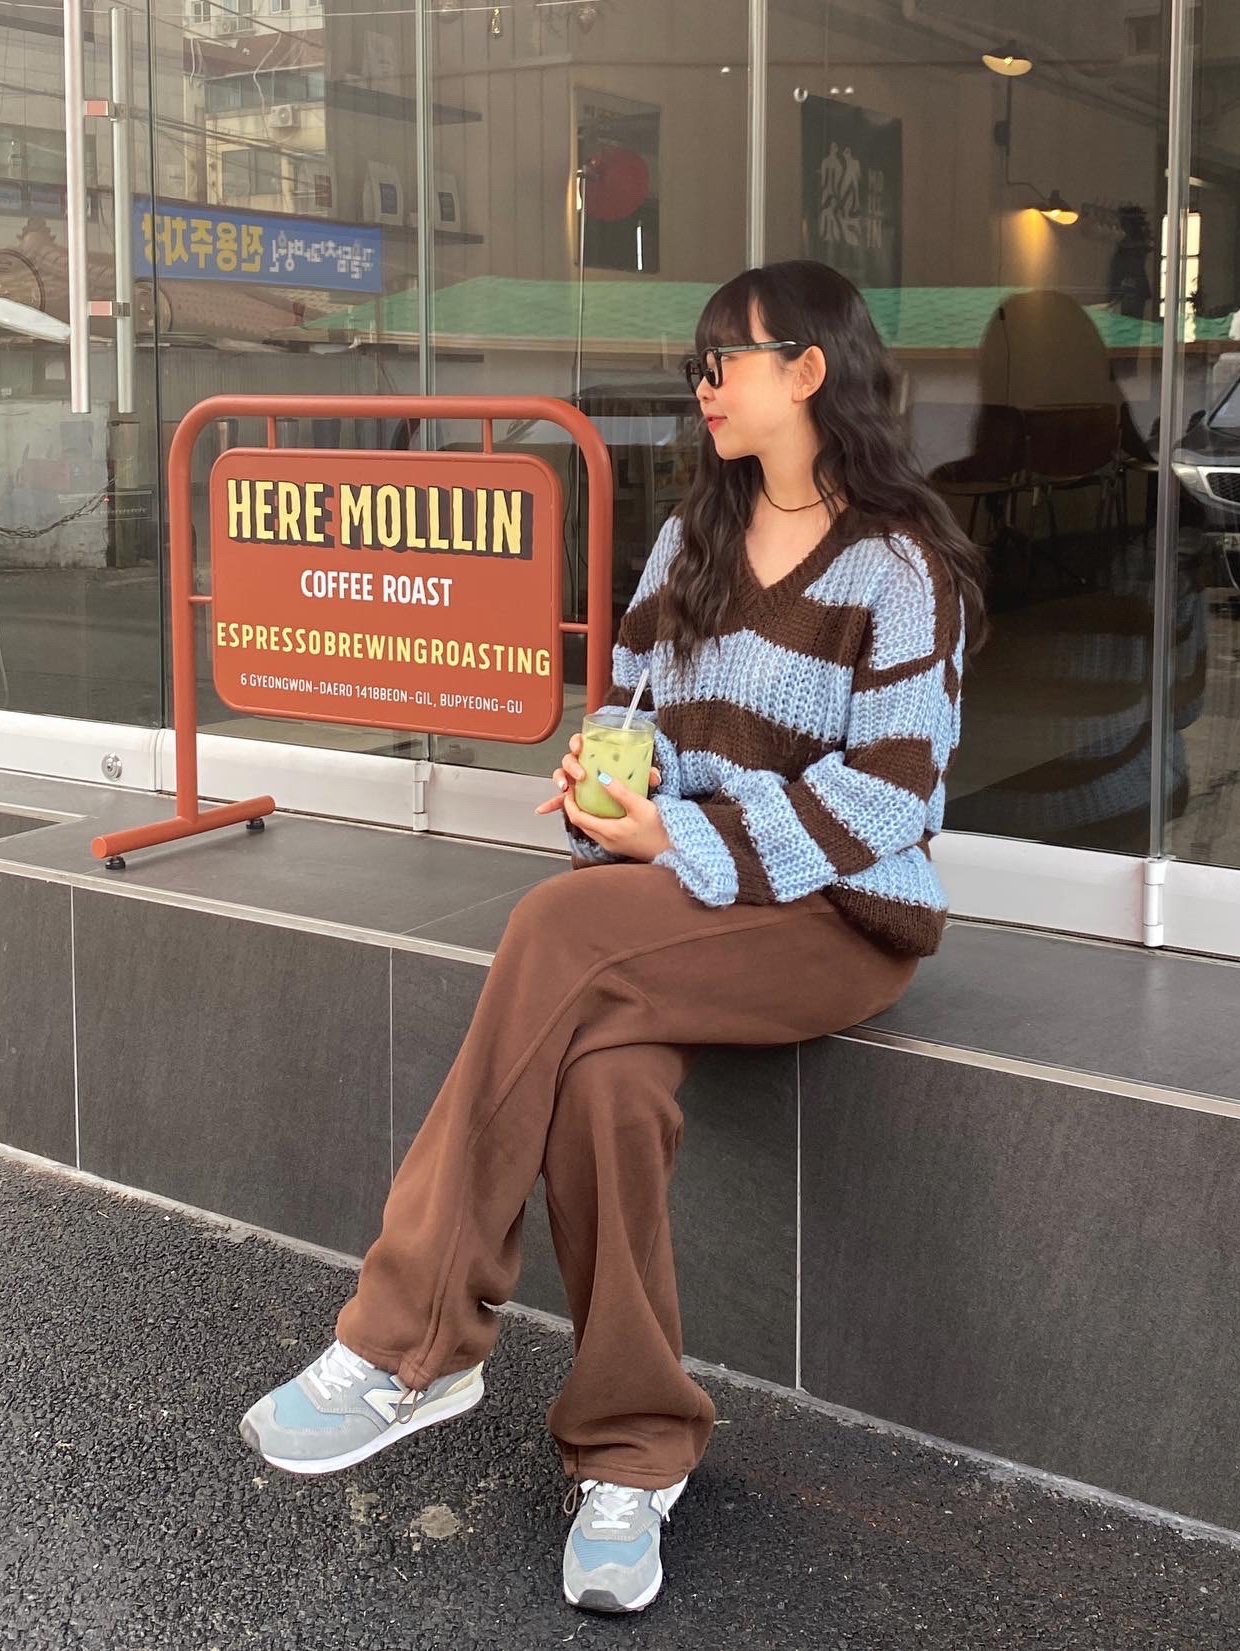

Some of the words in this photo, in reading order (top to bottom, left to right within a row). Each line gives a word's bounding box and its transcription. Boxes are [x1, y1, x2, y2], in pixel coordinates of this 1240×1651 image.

[227, 478, 334, 548] HERE
[339, 484, 533, 560] MOLLLIN
[300, 569, 374, 603] COFFEE
[382, 574, 453, 607] ROAST
[240, 673, 248, 687] 6
[249, 673, 353, 698] GYEONGWON-DAERO
[355, 684, 437, 708] 1418BEON-GIL,
[439, 693, 524, 715] BUPYEONG-GU
